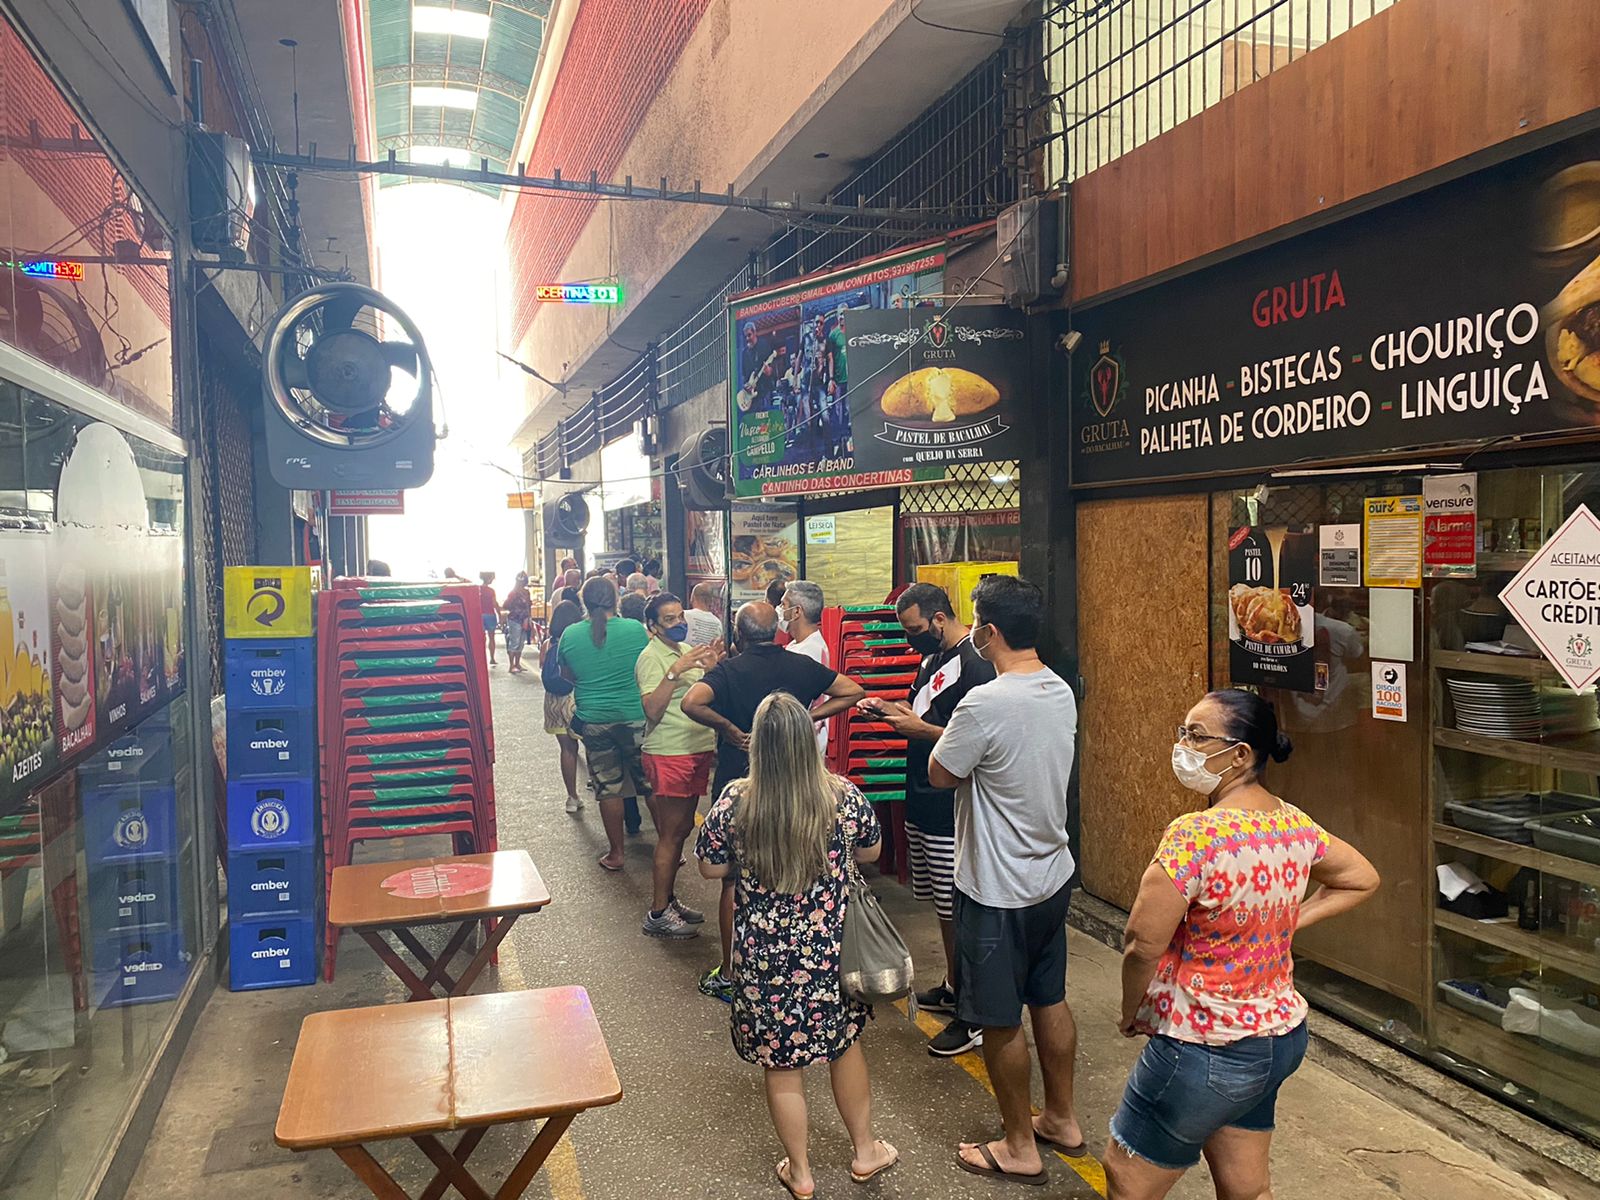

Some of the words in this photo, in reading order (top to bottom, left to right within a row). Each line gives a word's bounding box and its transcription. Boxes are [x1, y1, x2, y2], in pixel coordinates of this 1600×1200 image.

[1252, 269, 1346, 328] GRUTA
[923, 350, 956, 359] GRUTA
[1145, 373, 1220, 415] PICANHA
[1241, 346, 1343, 397] BISTECAS
[1370, 302, 1539, 371] CHOURIÇO
[1140, 417, 1214, 455] PALHETA
[1220, 411, 1244, 445] DE
[1252, 390, 1371, 440] CORDEIRO
[1401, 360, 1549, 420] LINGUIÇA
[895, 430, 931, 444] PASTEL
[933, 432, 946, 444] DE
[949, 423, 994, 443] BACALHAU
[1081, 419, 1130, 444] GRUTA
[915, 450, 944, 462] QUEIJO
[945, 449, 956, 459] DA
[957, 447, 984, 458] SERRA
[752, 463, 806, 479] CARLINHOS
[808, 461, 815, 474] E
[826, 457, 855, 472] BAND
[761, 477, 808, 494] CANTINHO
[811, 475, 832, 490] DAS
[833, 469, 912, 487] CONCERTINAS
[1425, 497, 1474, 509] verisure
[1427, 519, 1472, 532] Alarme
[1245, 557, 1262, 581] 10
[1525, 578, 1600, 601] CARTÕE
[250, 668, 286, 677] ambev
[1566, 658, 1592, 667] GRUTA
[1376, 684, 1401, 692] DISQUE
[1376, 691, 1401, 703] 100
[109, 703, 126, 724] VINHOS
[62, 724, 94, 752] BACALHAU
[250, 739, 289, 749] ambev
[12, 751, 43, 783] AZEITES
[250, 880, 290, 891] ambev
[251, 947, 290, 959] ambev
